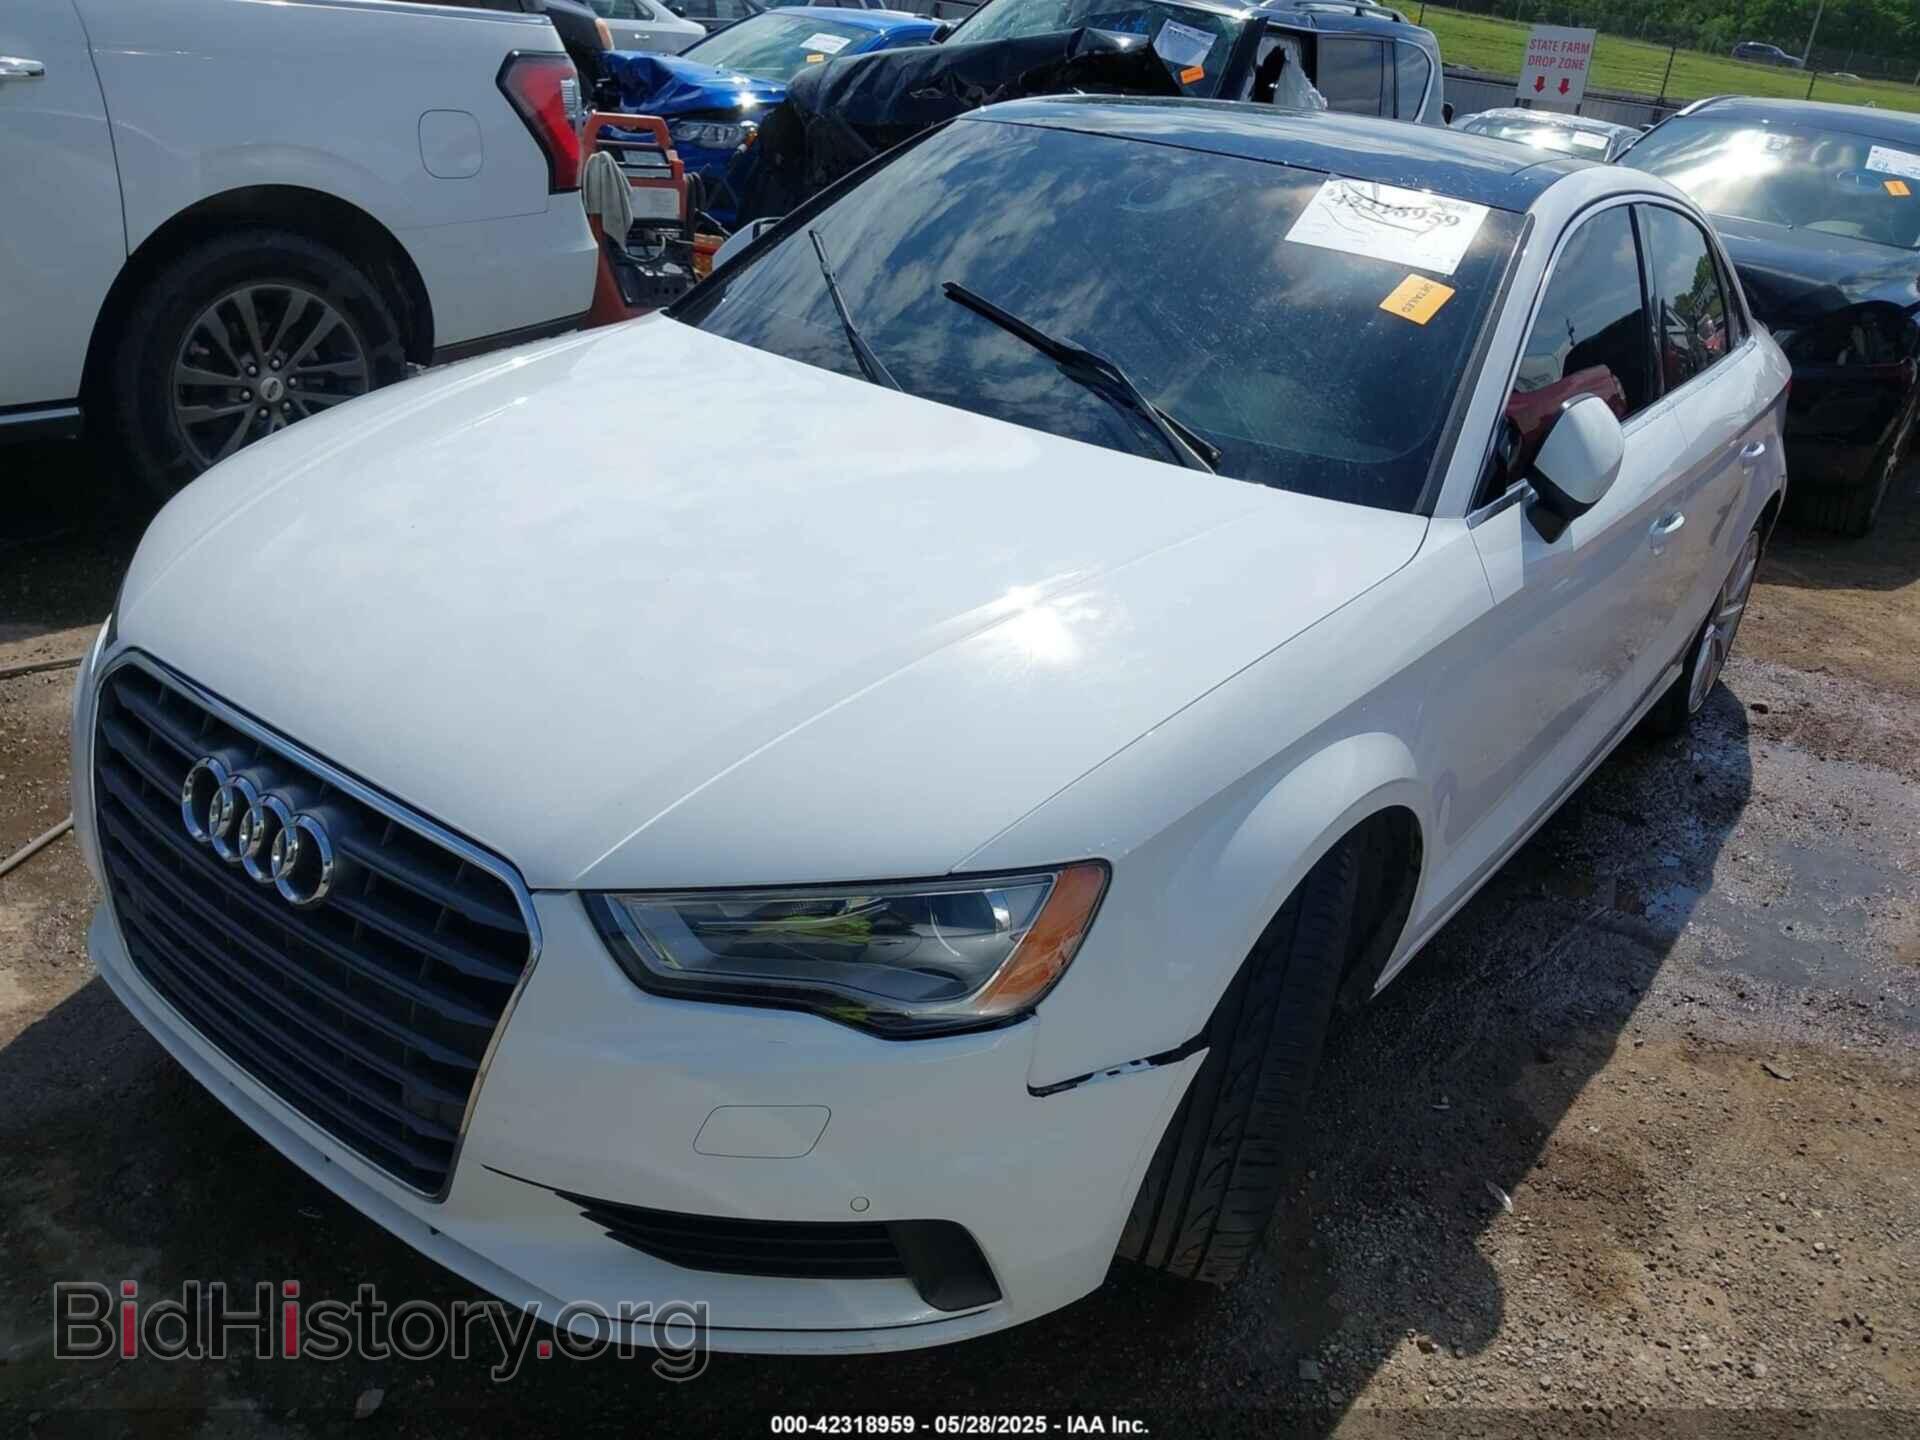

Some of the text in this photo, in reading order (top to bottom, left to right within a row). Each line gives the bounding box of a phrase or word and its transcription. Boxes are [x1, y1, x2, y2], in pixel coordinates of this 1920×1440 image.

[1528, 38, 1591, 55] STATE FARM
[1527, 54, 1586, 70] DROP ZONE
